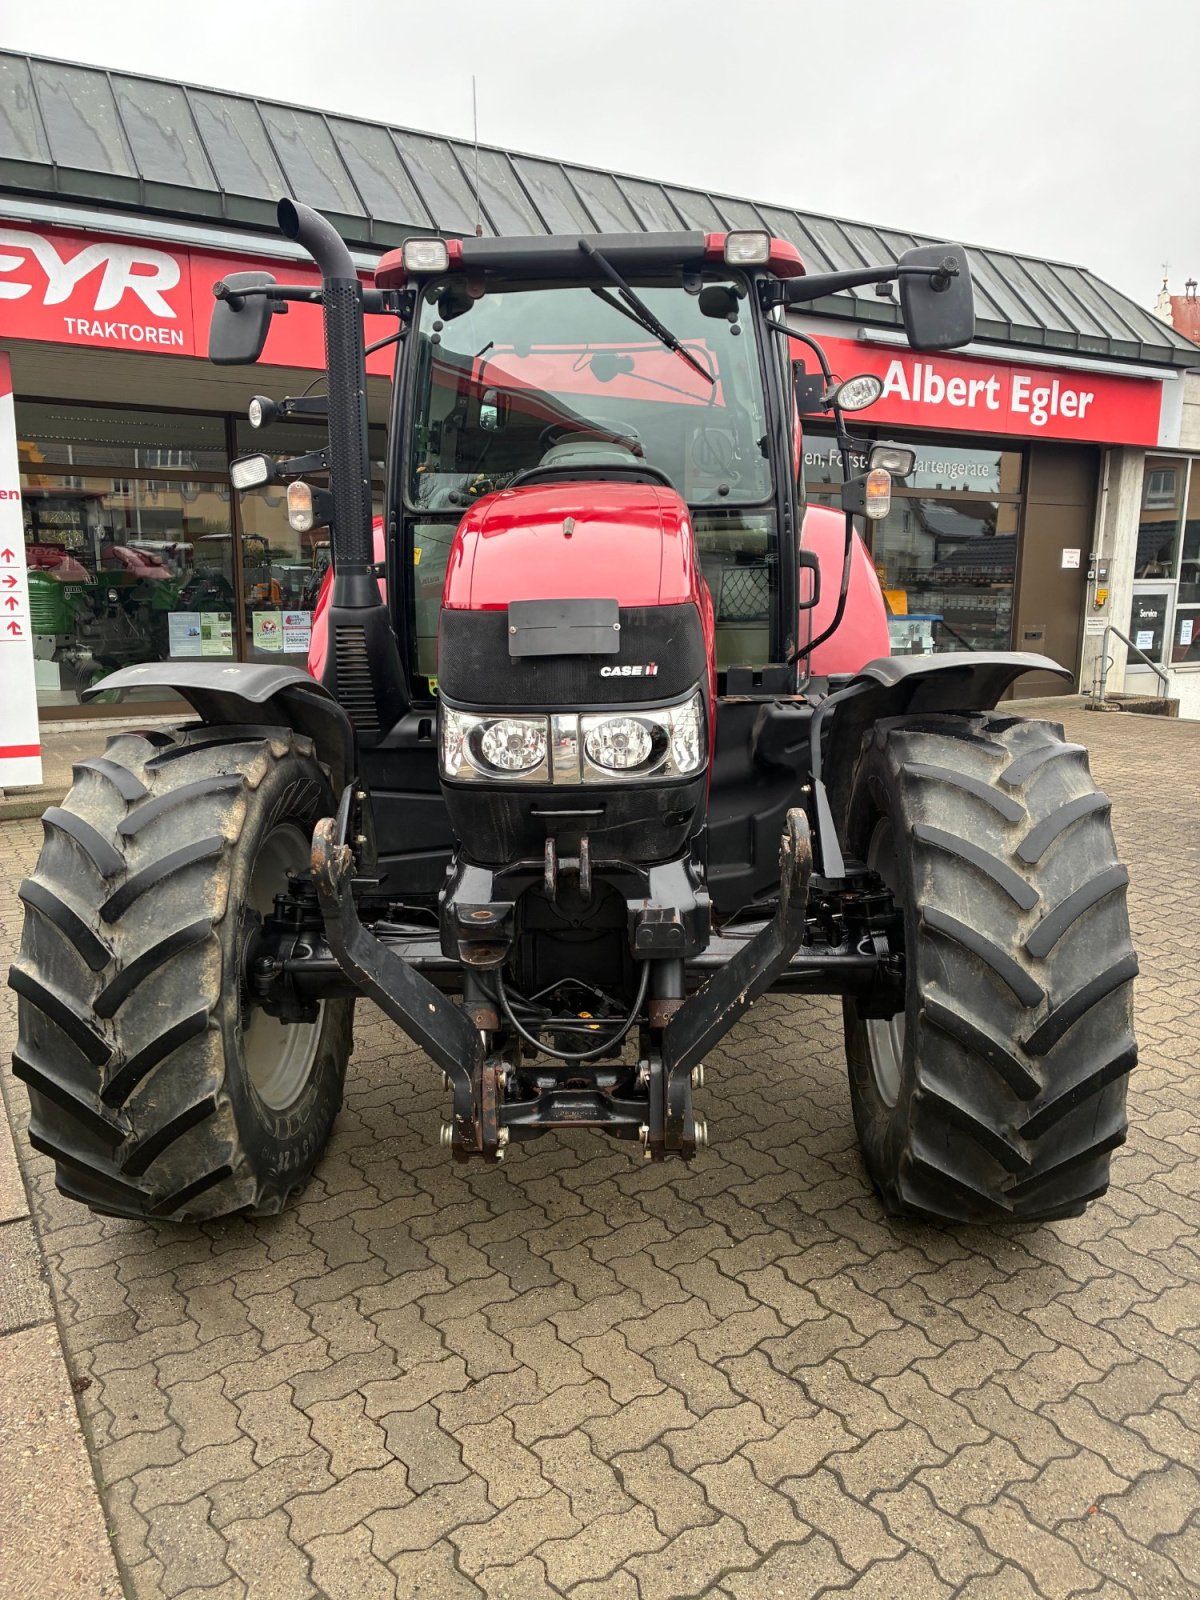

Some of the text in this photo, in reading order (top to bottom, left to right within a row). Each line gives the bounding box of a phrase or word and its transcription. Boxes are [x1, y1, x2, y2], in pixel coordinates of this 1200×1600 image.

[64, 317, 183, 346] TRAKTOREN
[881, 359, 1094, 426] Albert Egler
[0, 490, 20, 500] en
[1140, 608, 1158, 618] Service
[601, 665, 642, 677] CASE
